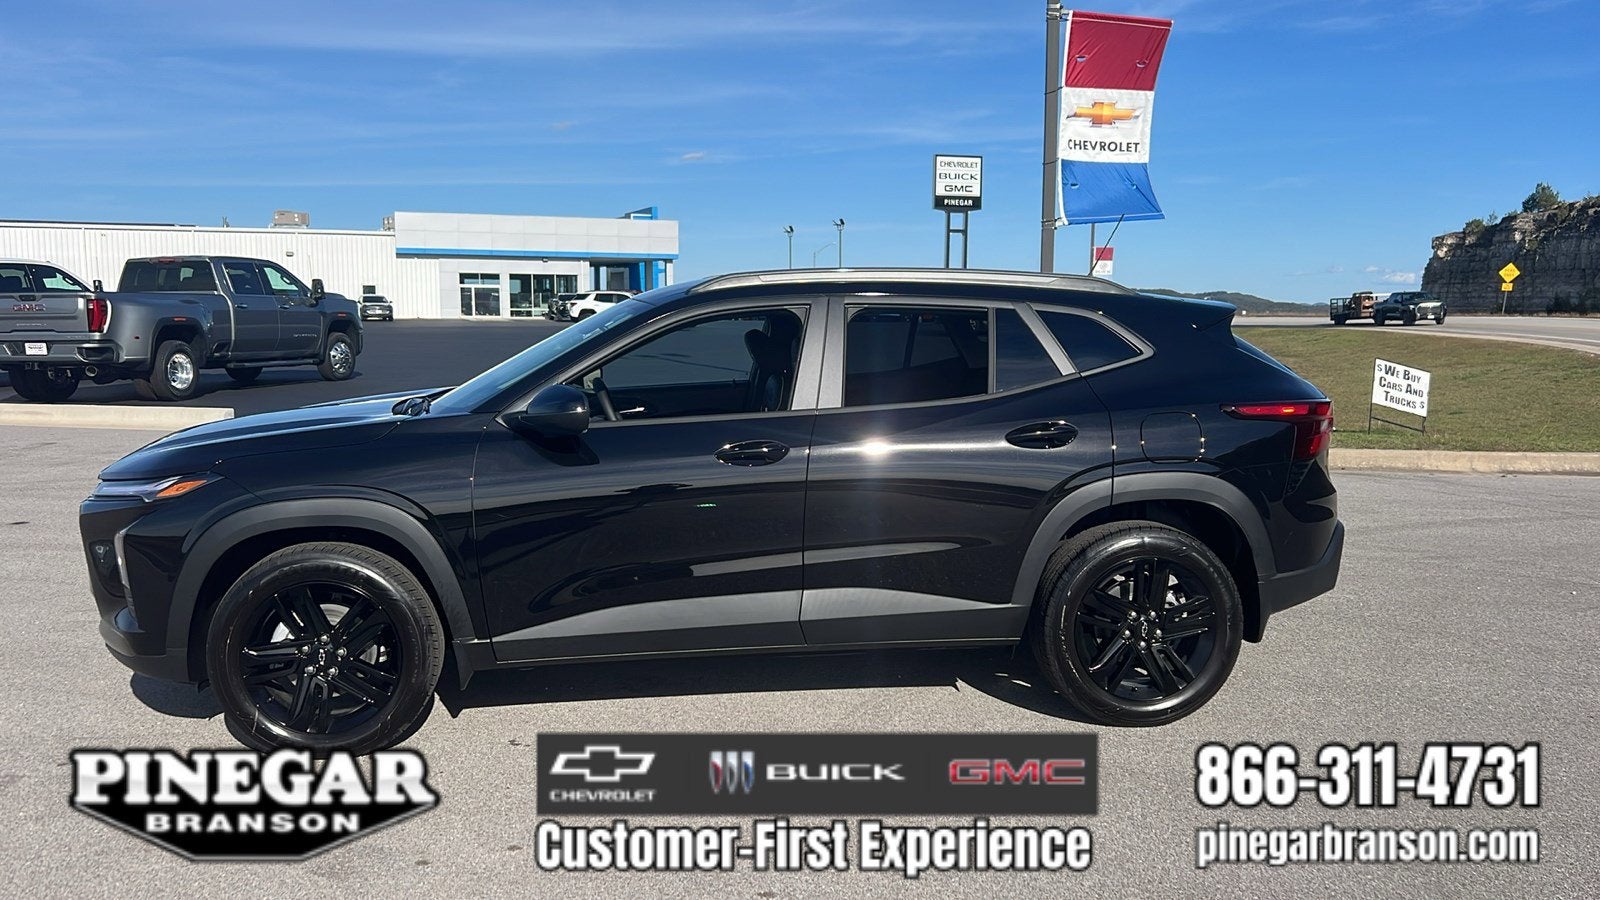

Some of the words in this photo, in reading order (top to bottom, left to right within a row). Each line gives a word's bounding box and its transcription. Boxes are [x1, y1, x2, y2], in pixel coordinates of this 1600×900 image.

[1067, 138, 1140, 153] CHEVROLET
[939, 160, 979, 169] CHEVROLET
[938, 172, 979, 181] BUICK
[944, 184, 973, 193] GMC
[944, 198, 973, 206] PINEGAR
